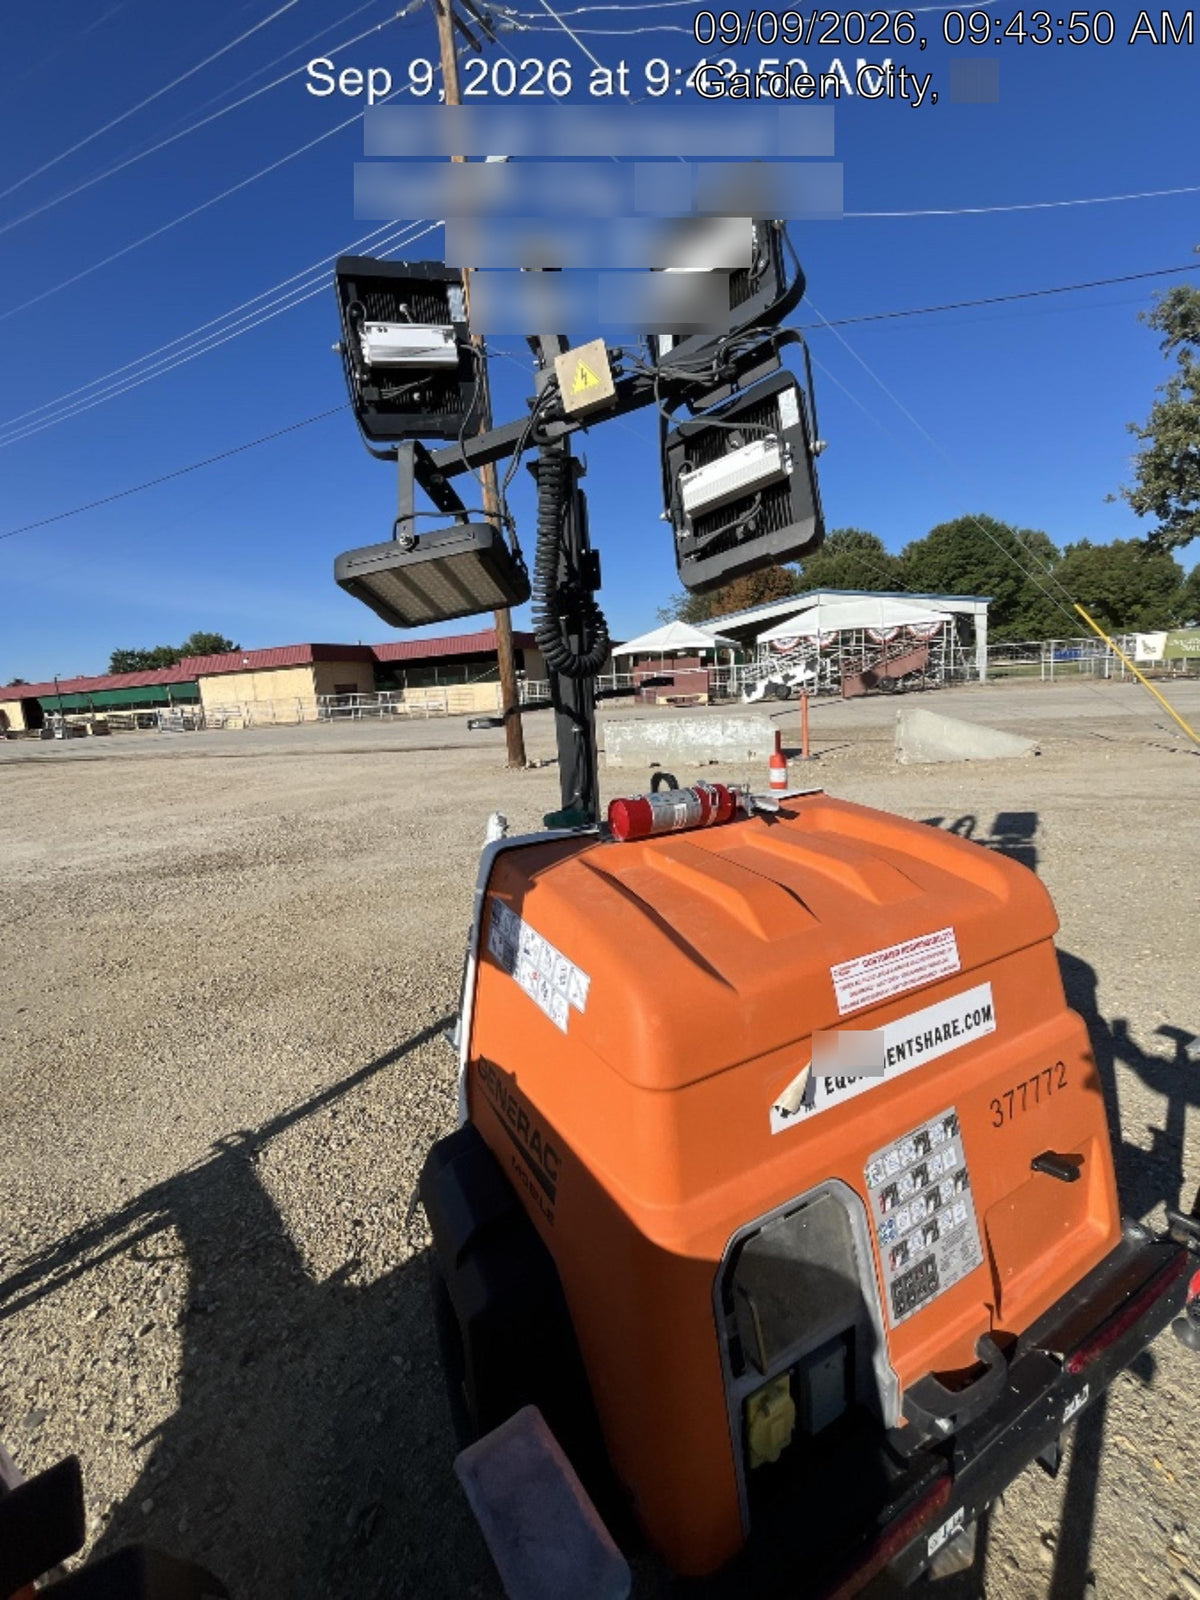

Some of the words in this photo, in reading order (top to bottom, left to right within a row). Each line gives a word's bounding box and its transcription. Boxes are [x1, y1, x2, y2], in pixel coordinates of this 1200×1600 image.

[824, 1004, 992, 1095] EQENTSHARE.COM
[989, 1060, 1068, 1128] 377772
[477, 1055, 559, 1182] GENERAC
